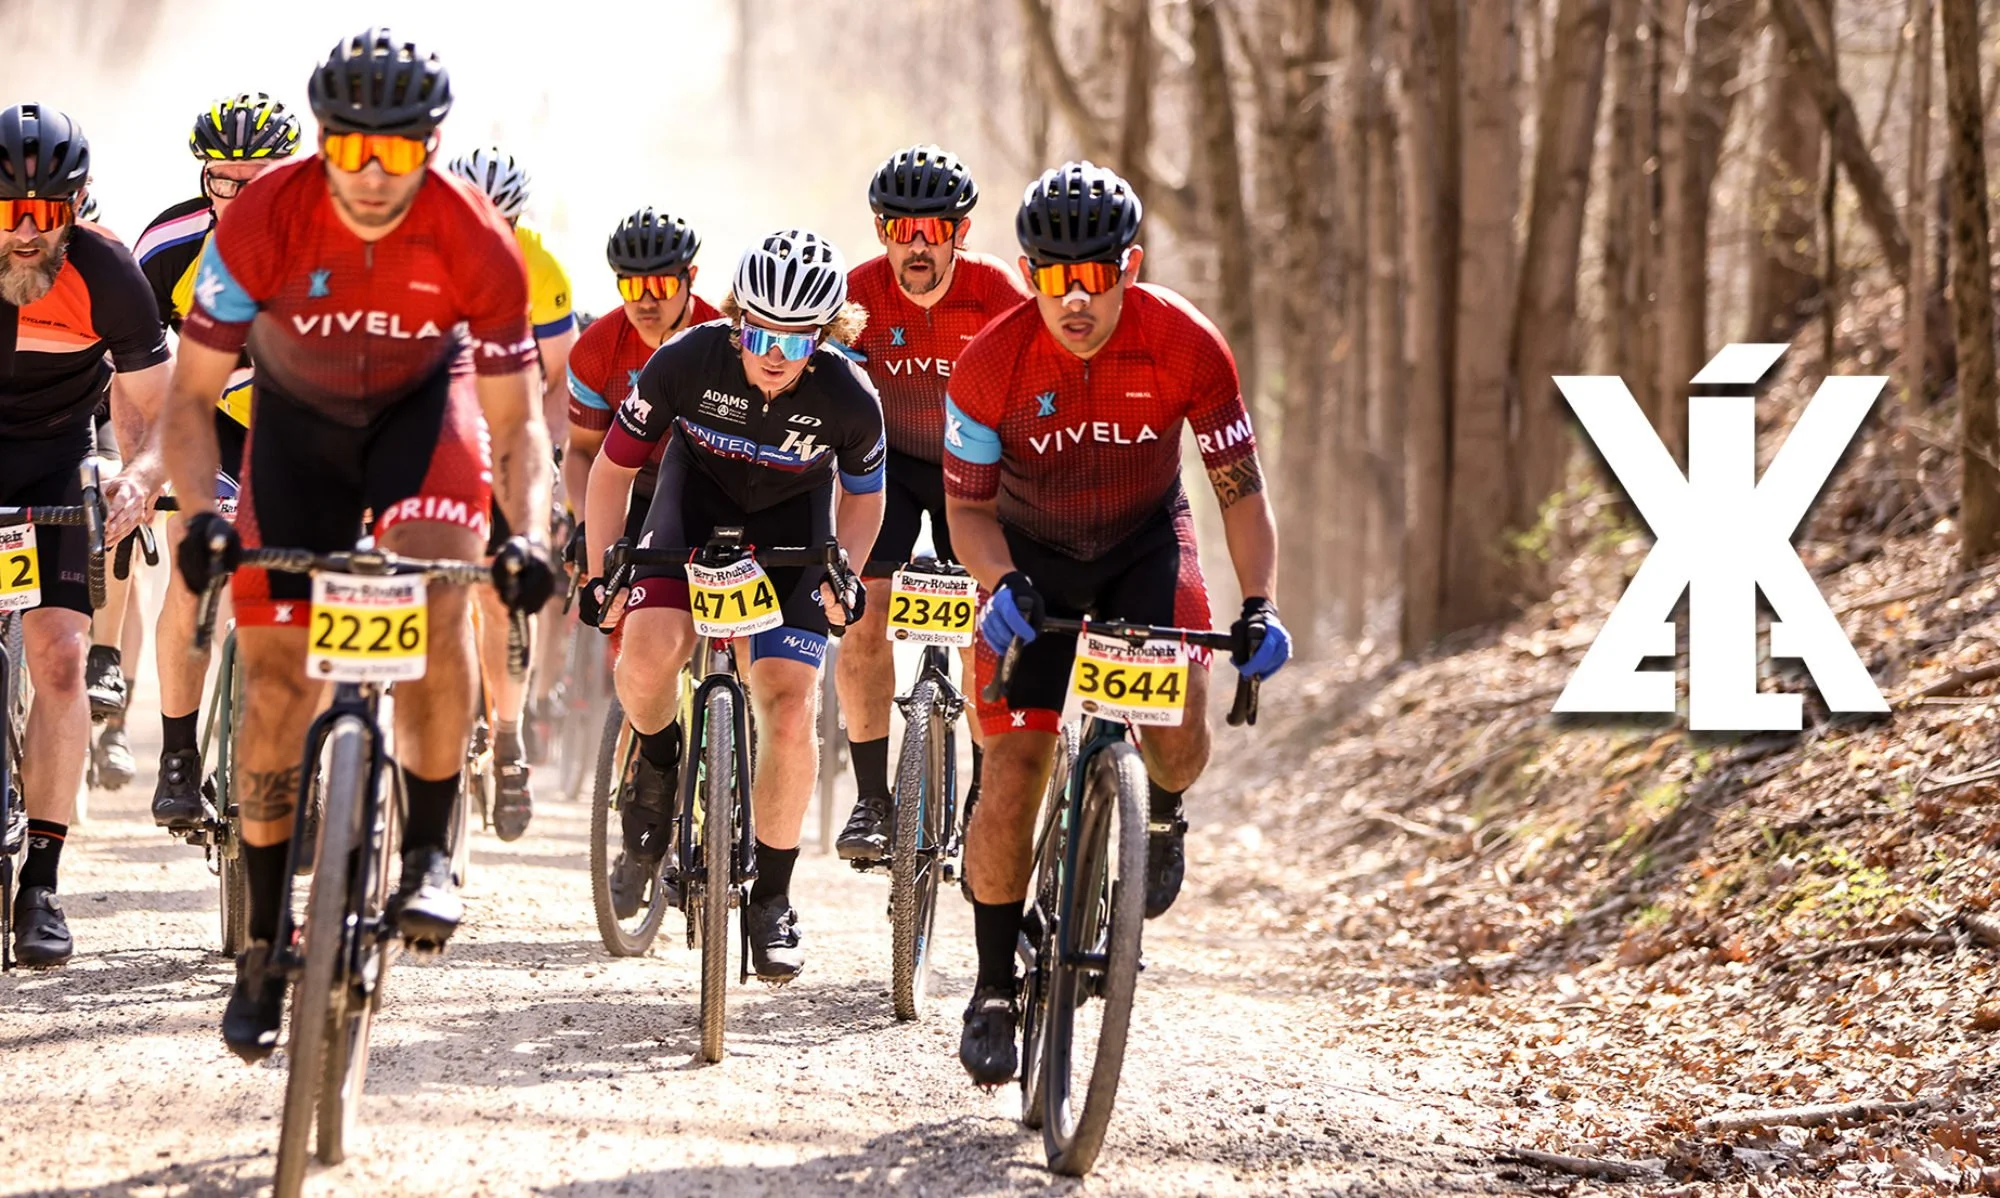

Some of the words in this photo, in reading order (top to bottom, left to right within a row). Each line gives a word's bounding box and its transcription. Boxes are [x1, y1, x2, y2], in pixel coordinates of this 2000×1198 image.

[292, 310, 441, 340] VIVELA
[702, 389, 749, 410] ADAMS
[1028, 421, 1159, 455] VIVELA
[0, 554, 33, 589] 2
[693, 581, 774, 619] 4714
[892, 596, 970, 628] 2349
[315, 612, 421, 651] 2226
[1078, 662, 1180, 703] 3644
